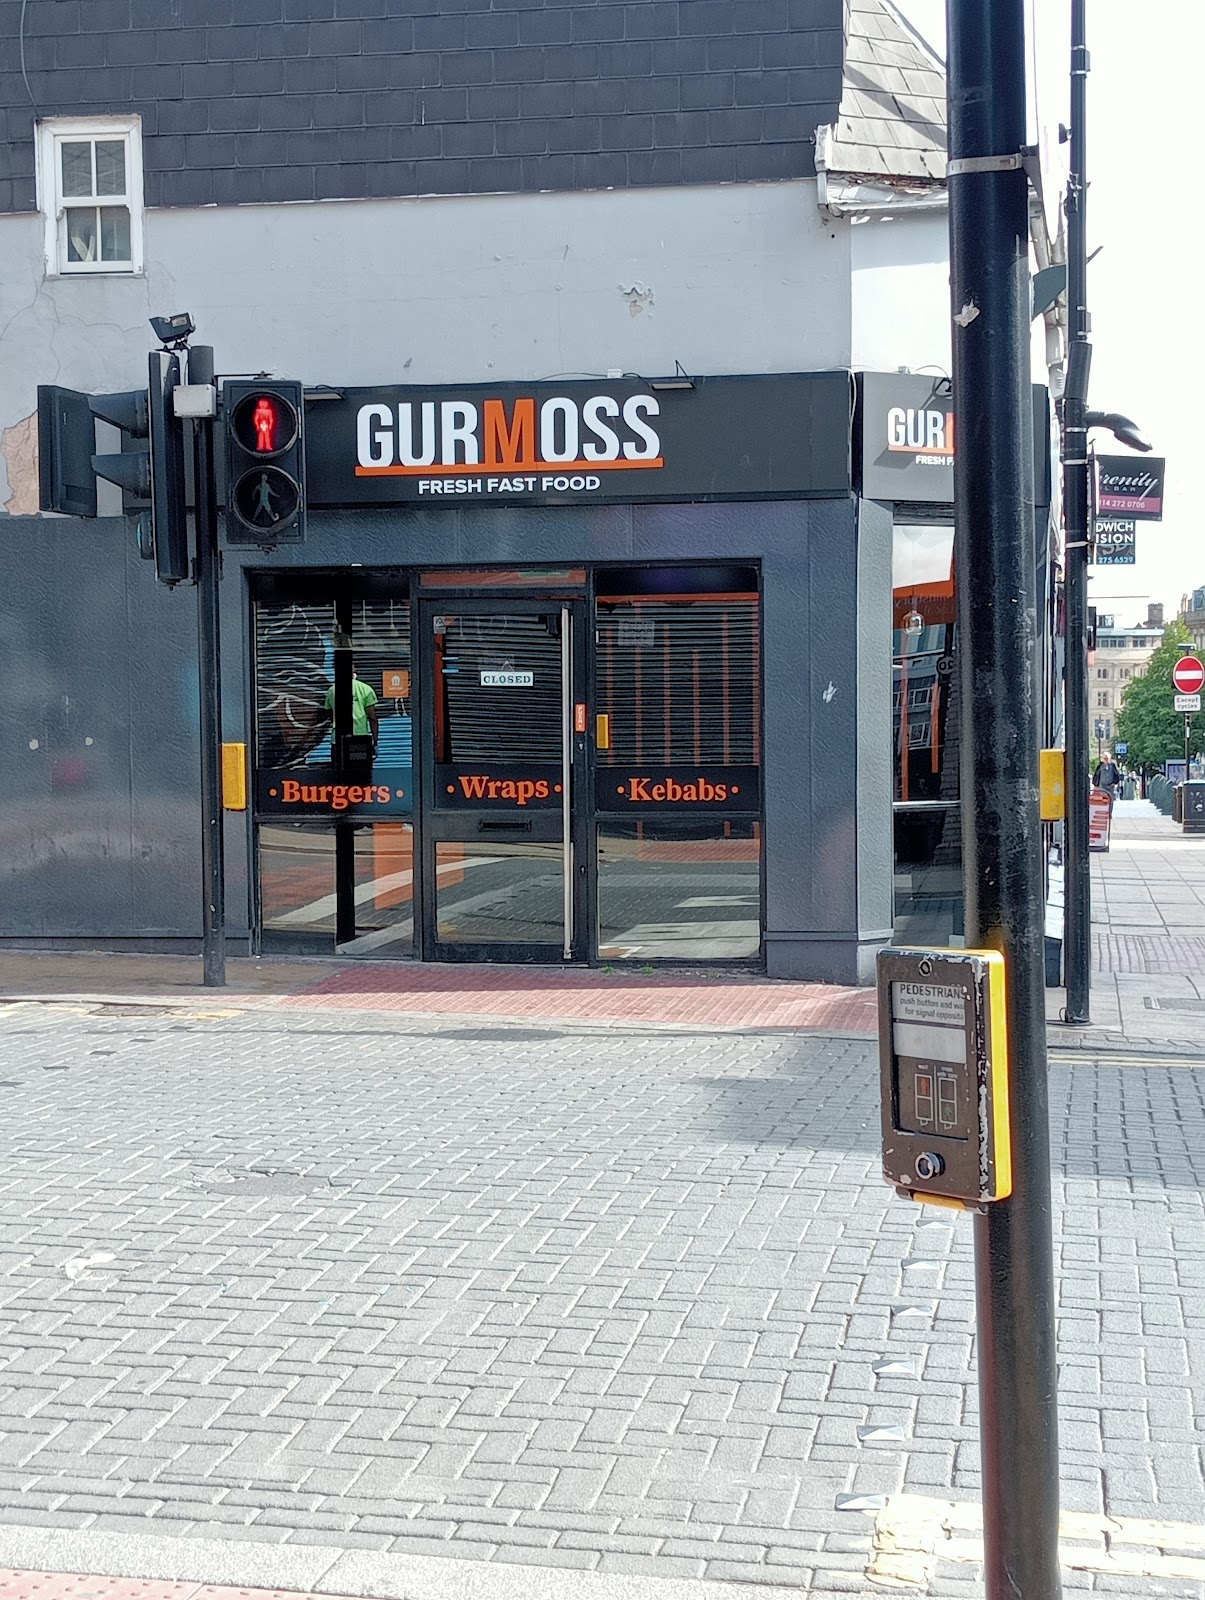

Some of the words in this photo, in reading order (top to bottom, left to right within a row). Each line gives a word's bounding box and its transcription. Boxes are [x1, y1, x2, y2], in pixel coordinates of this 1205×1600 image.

[356, 394, 660, 468] GURMOSS
[916, 455, 945, 465] FRESH
[418, 479, 482, 494] FRESH
[487, 477, 537, 493] FAST
[542, 476, 600, 491] FOOD
[1096, 522, 1133, 532] DWICH
[1096, 533, 1133, 543] ISION
[483, 675, 531, 684] CLOSED
[281, 779, 391, 809] Burgers
[458, 775, 549, 805] Wraps
[628, 777, 727, 802] Kebabs
[900, 997, 916, 1005] push
[916, 998, 939, 1007] button
[940, 1001, 953, 1009] and
[905, 1006, 915, 1014] for
[916, 1008, 935, 1018] signal
